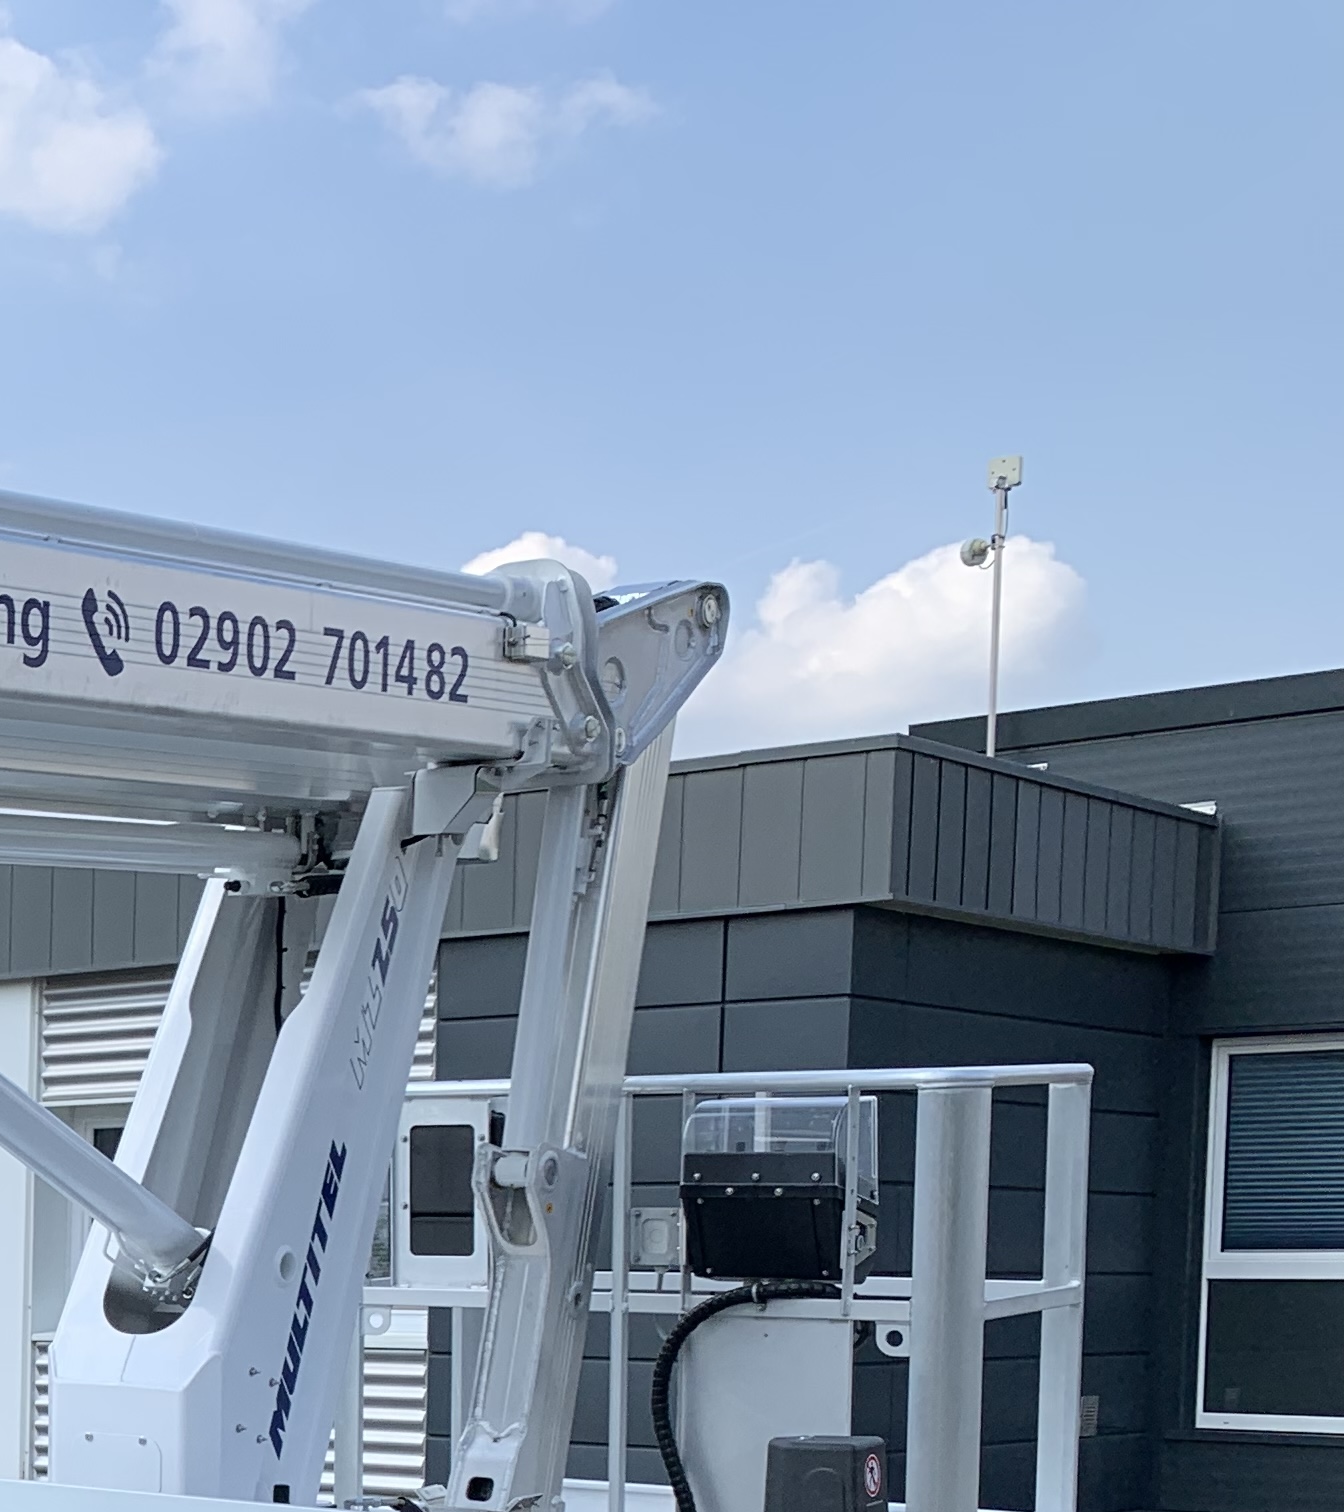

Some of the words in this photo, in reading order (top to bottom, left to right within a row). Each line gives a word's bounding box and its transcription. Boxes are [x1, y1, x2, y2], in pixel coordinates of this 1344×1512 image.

[155, 600, 297, 681] 02902
[323, 625, 470, 704] 701482
[269, 1139, 347, 1460] MULTITEL
